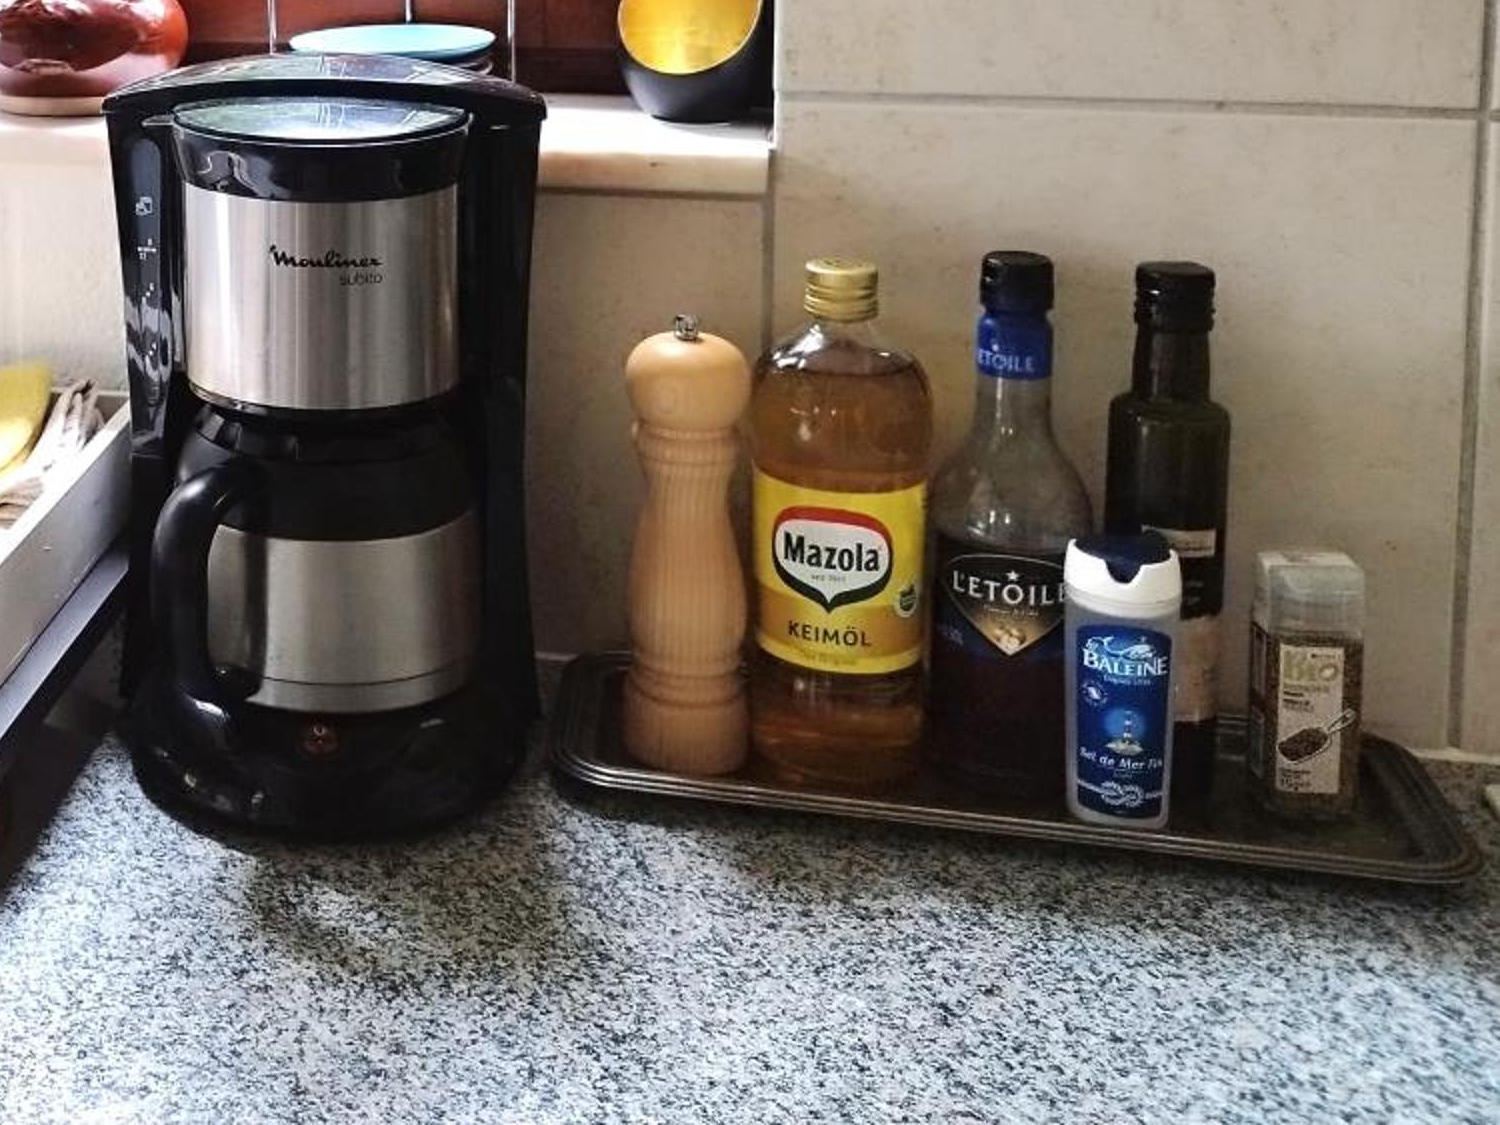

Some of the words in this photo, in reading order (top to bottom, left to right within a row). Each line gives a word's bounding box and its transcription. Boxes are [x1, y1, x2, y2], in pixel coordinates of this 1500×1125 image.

[784, 531, 880, 572] Mazola
[787, 620, 872, 648] KEIMÖL
[1082, 648, 1169, 677] BALEINE
